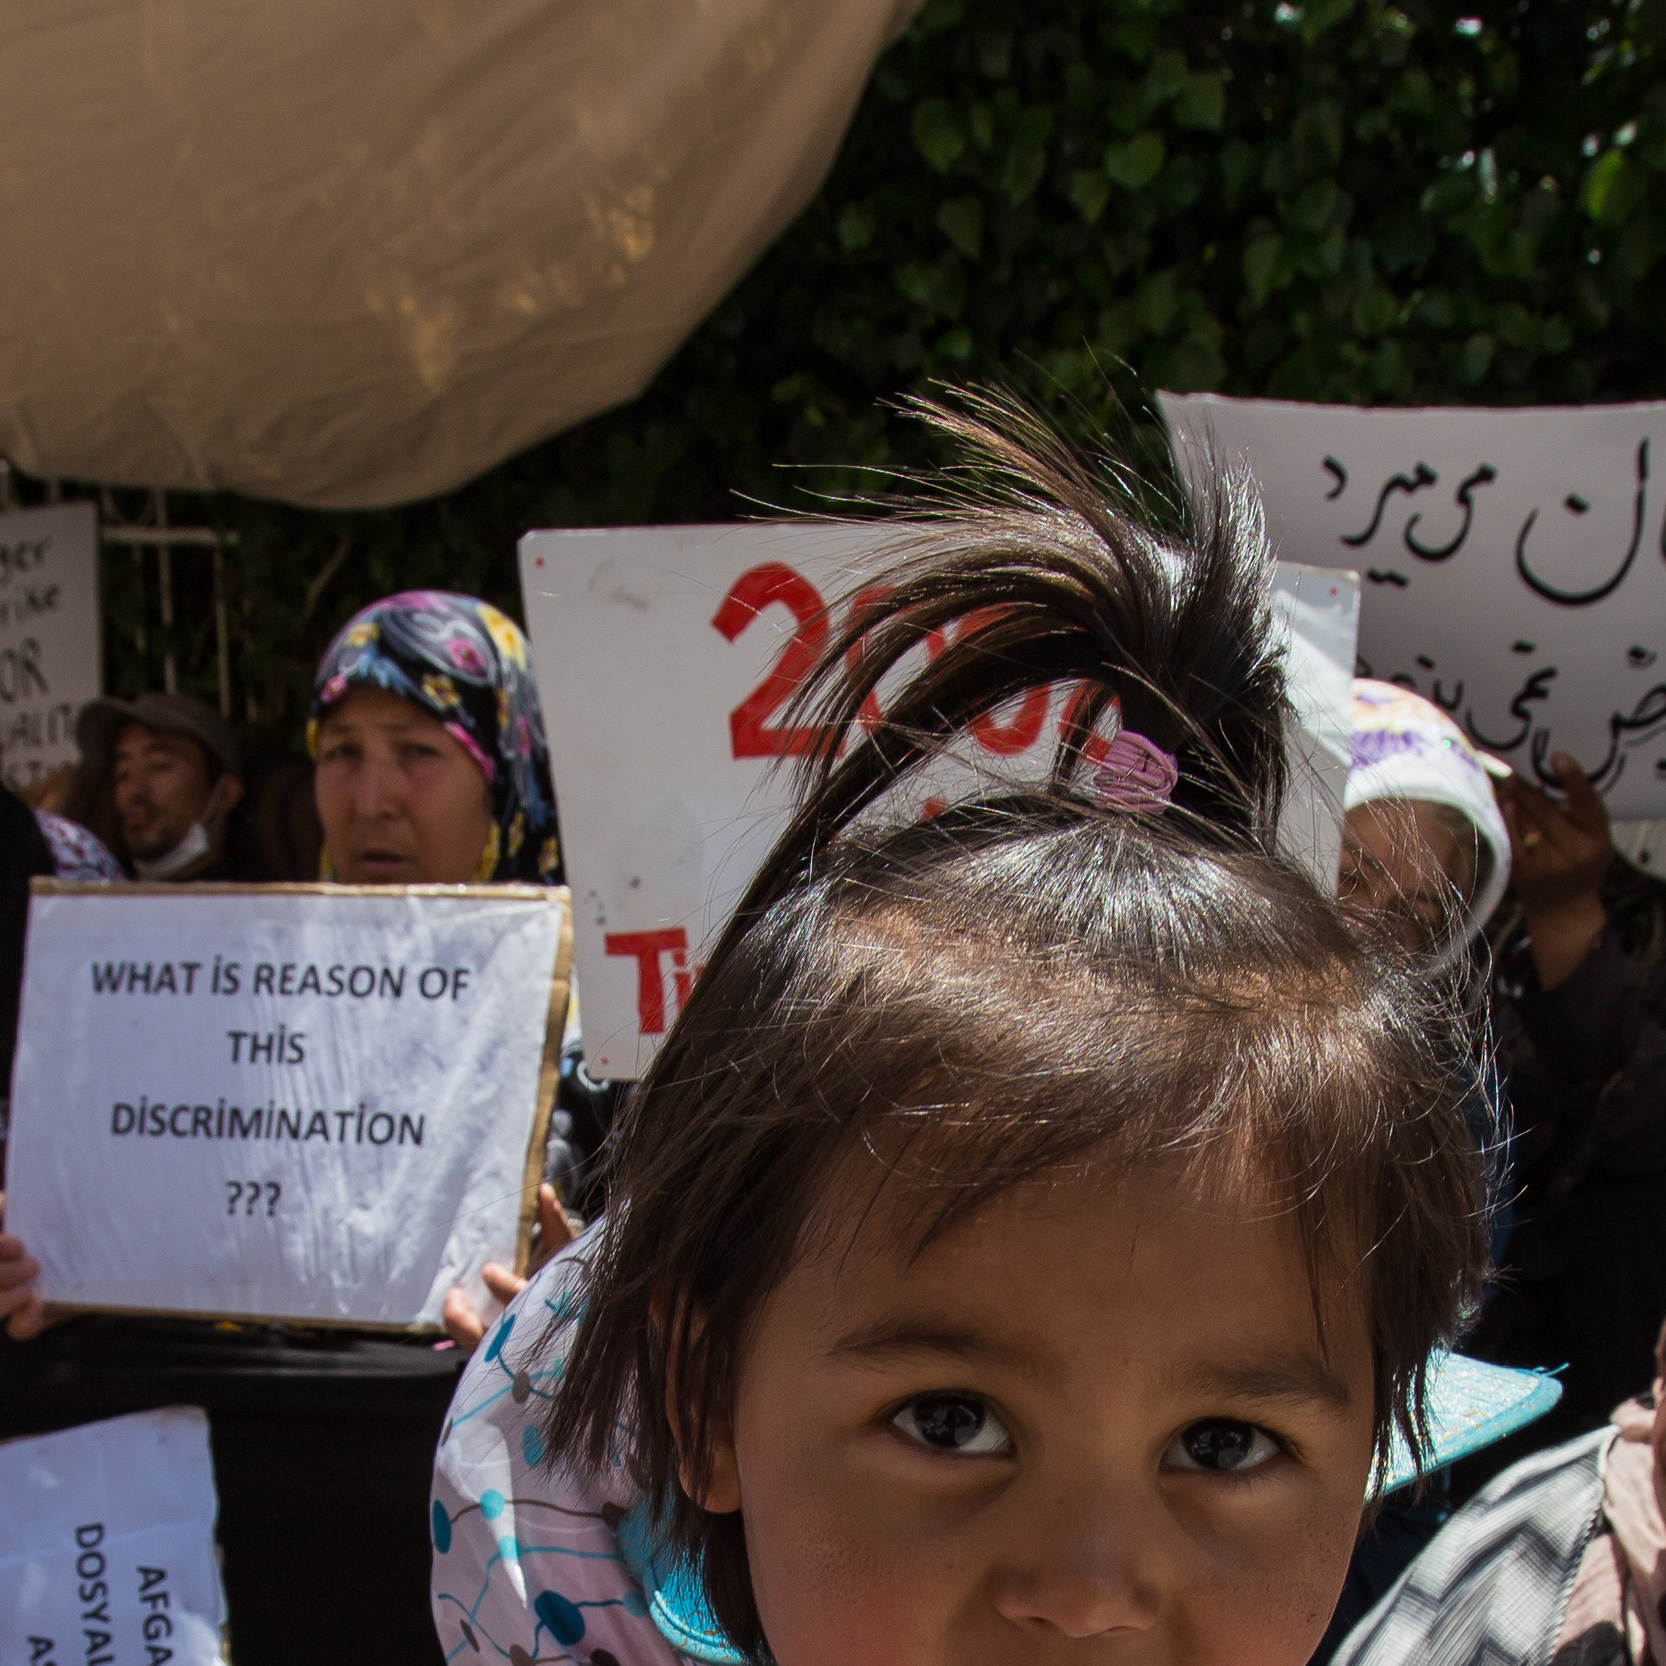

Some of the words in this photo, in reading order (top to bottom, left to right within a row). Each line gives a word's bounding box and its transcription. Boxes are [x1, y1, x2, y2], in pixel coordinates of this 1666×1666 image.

[91, 960, 201, 996] WHAT
[253, 962, 403, 999] REASON
[418, 965, 469, 1002] OF
[225, 1179, 281, 1216] ???
